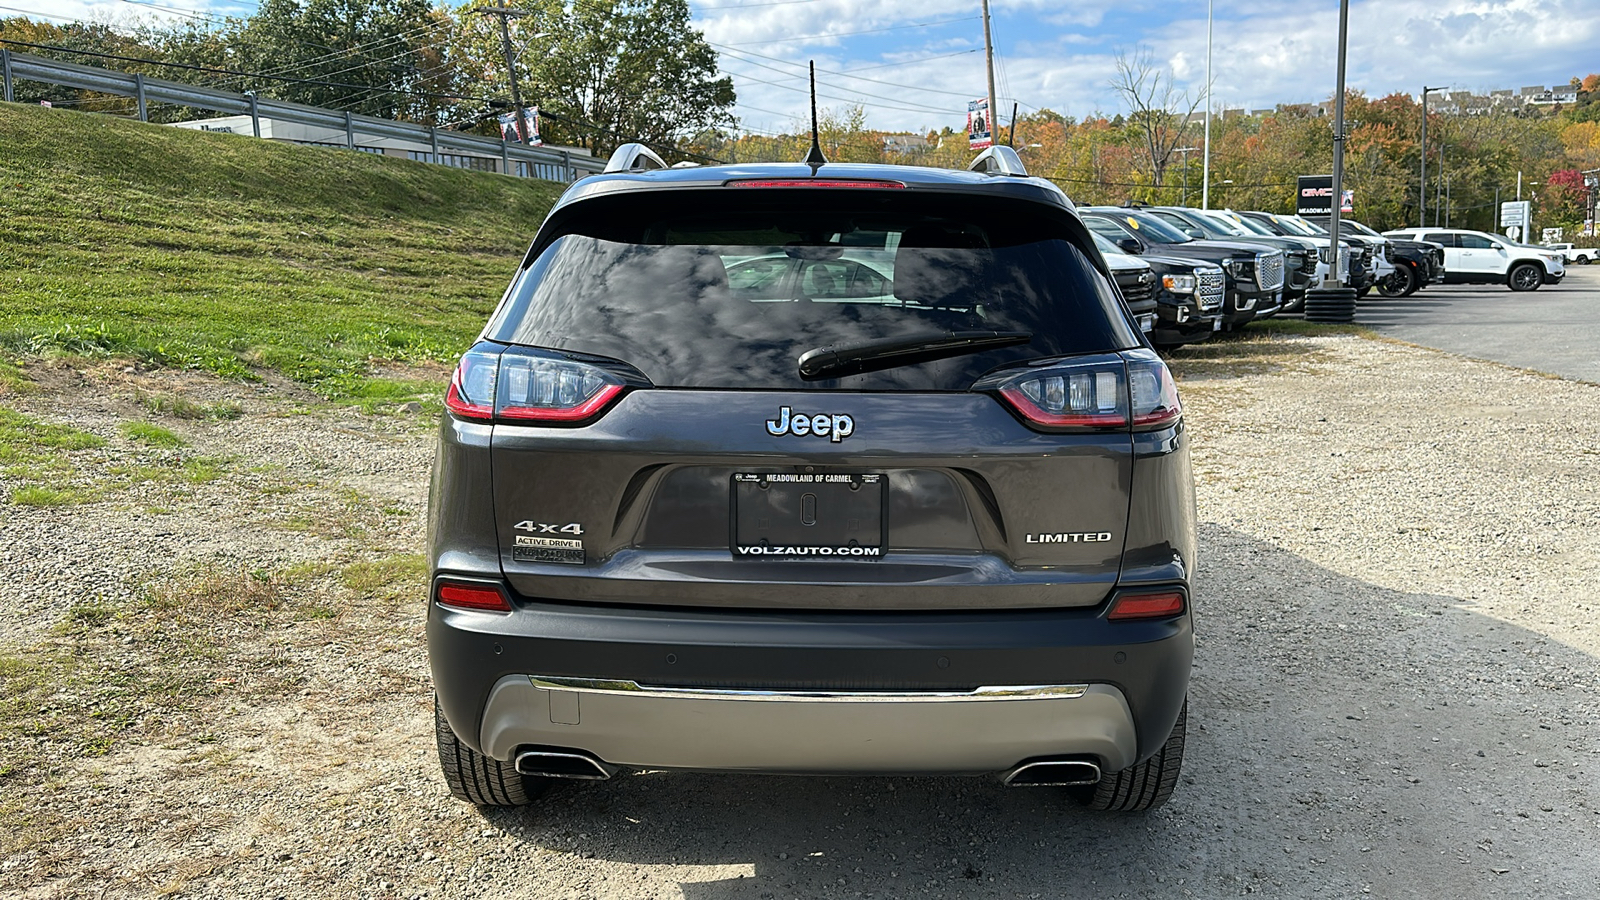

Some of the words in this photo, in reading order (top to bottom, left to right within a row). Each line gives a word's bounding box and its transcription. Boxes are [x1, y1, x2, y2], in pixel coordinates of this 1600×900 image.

[1302, 188, 1333, 197] GMC
[766, 406, 854, 442] Jeep
[766, 474, 814, 482] MEADOWLAND
[825, 475, 853, 483] CARMEL
[517, 537, 547, 546] ACTIVE
[549, 539, 574, 547] DRIVE
[1026, 532, 1112, 543] LIMITED
[738, 546, 879, 556] VOLZAUTO.COM
